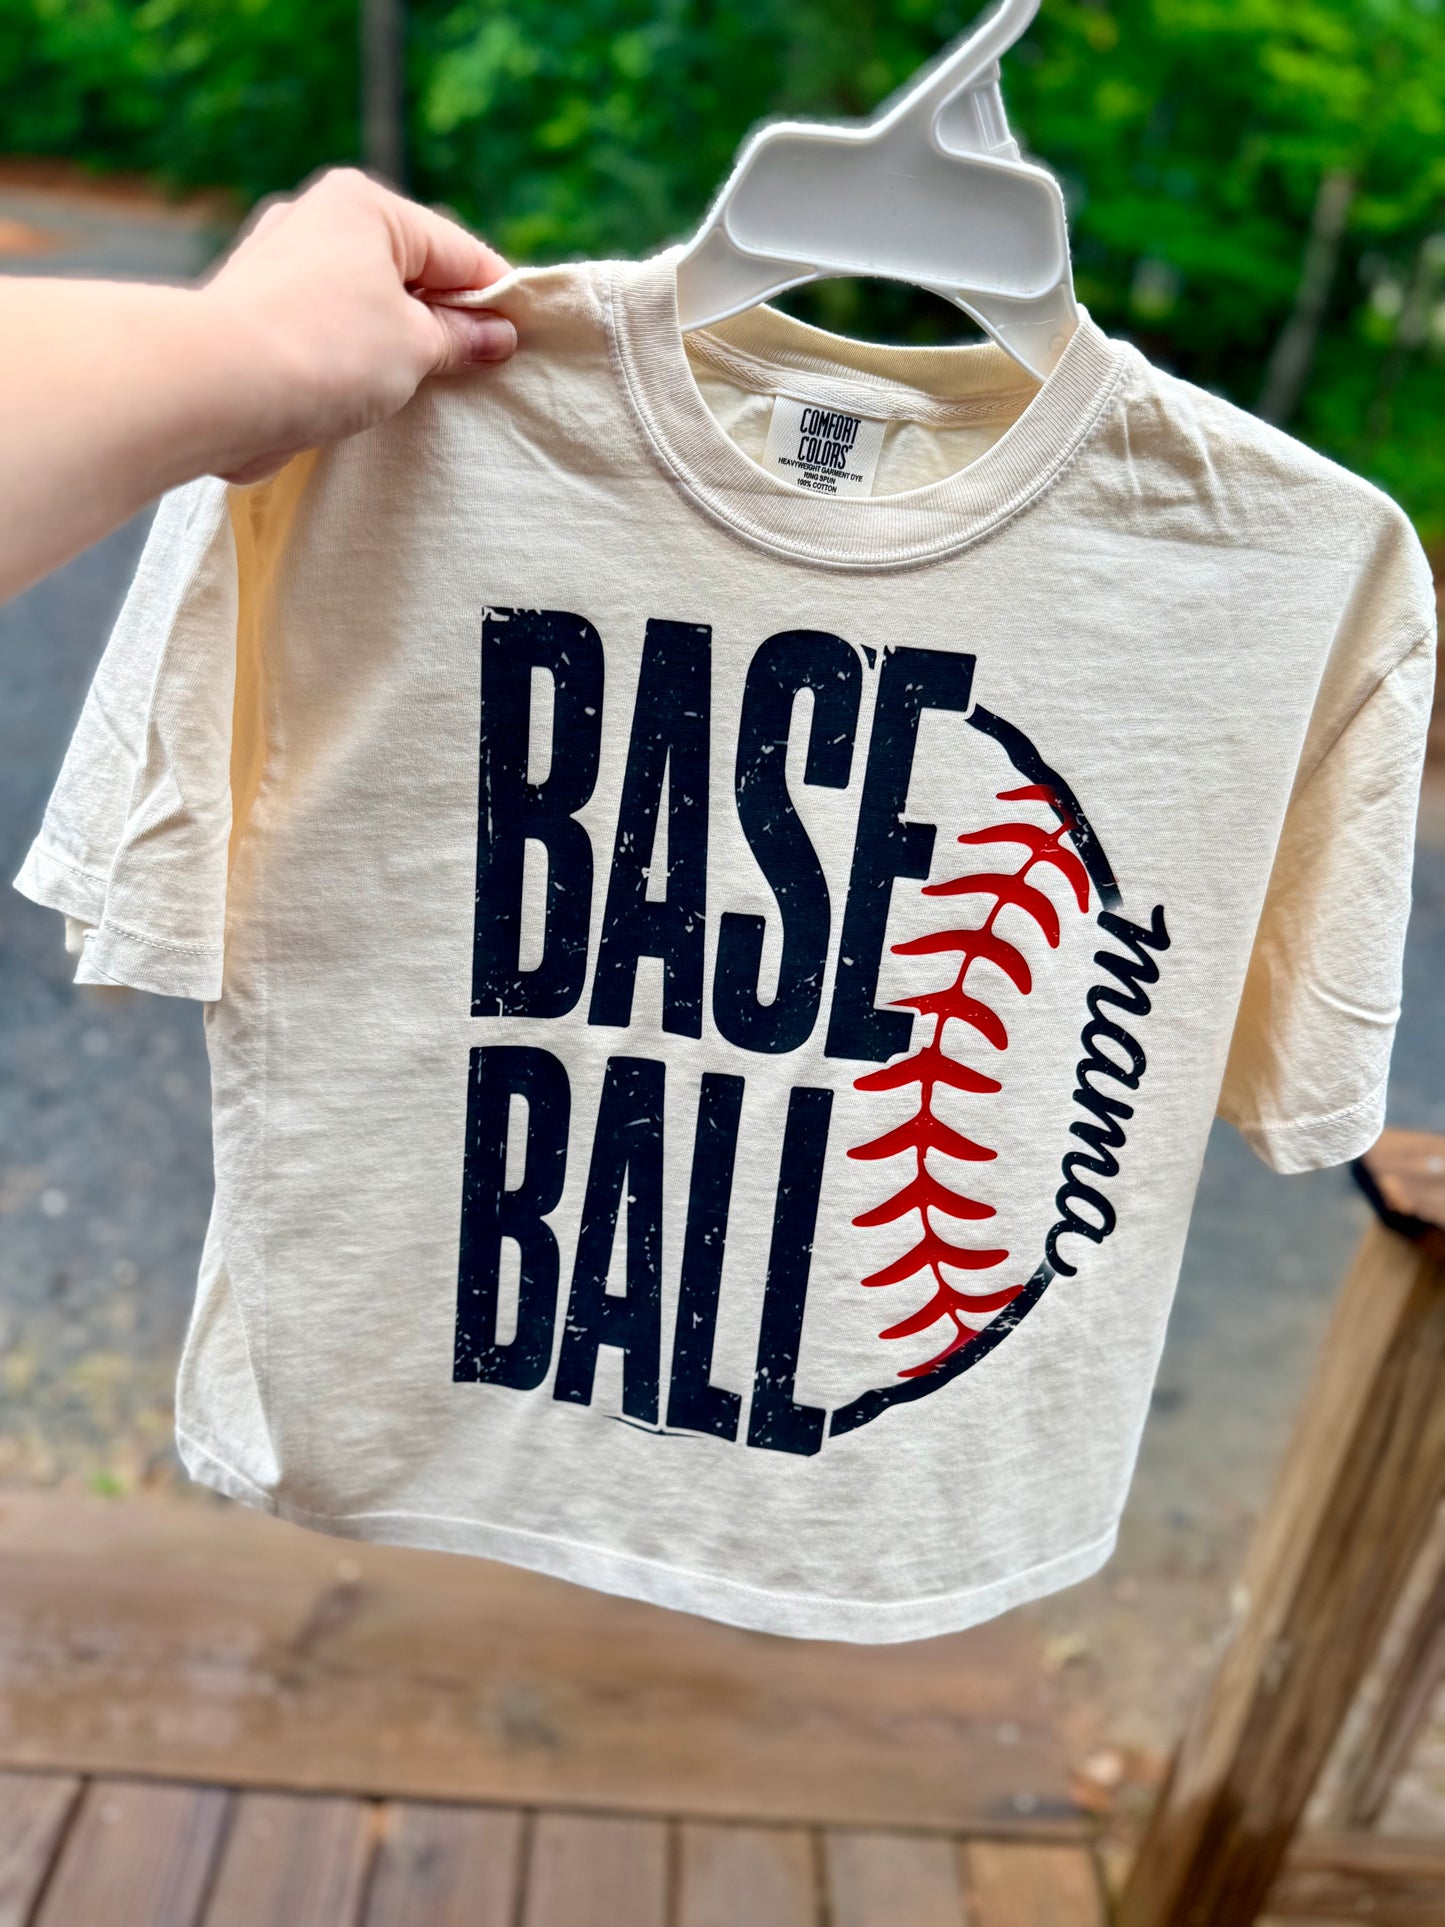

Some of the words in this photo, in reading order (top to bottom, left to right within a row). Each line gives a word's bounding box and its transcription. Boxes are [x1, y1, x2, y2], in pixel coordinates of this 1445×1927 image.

[800, 408, 861, 444] COMFORT
[778, 457, 821, 472] HEAVYWEIGHT
[821, 467, 850, 480] GARMENT
[850, 474, 863, 483] DYE
[797, 478, 812, 488] 100%
[812, 482, 837, 493] COTTON
[803, 471, 819, 481] RING
[819, 474, 836, 485] SPUN
[470, 606, 977, 1063] BASE
[1045, 904, 1171, 1277] mama
[453, 1045, 835, 1457] BALL
